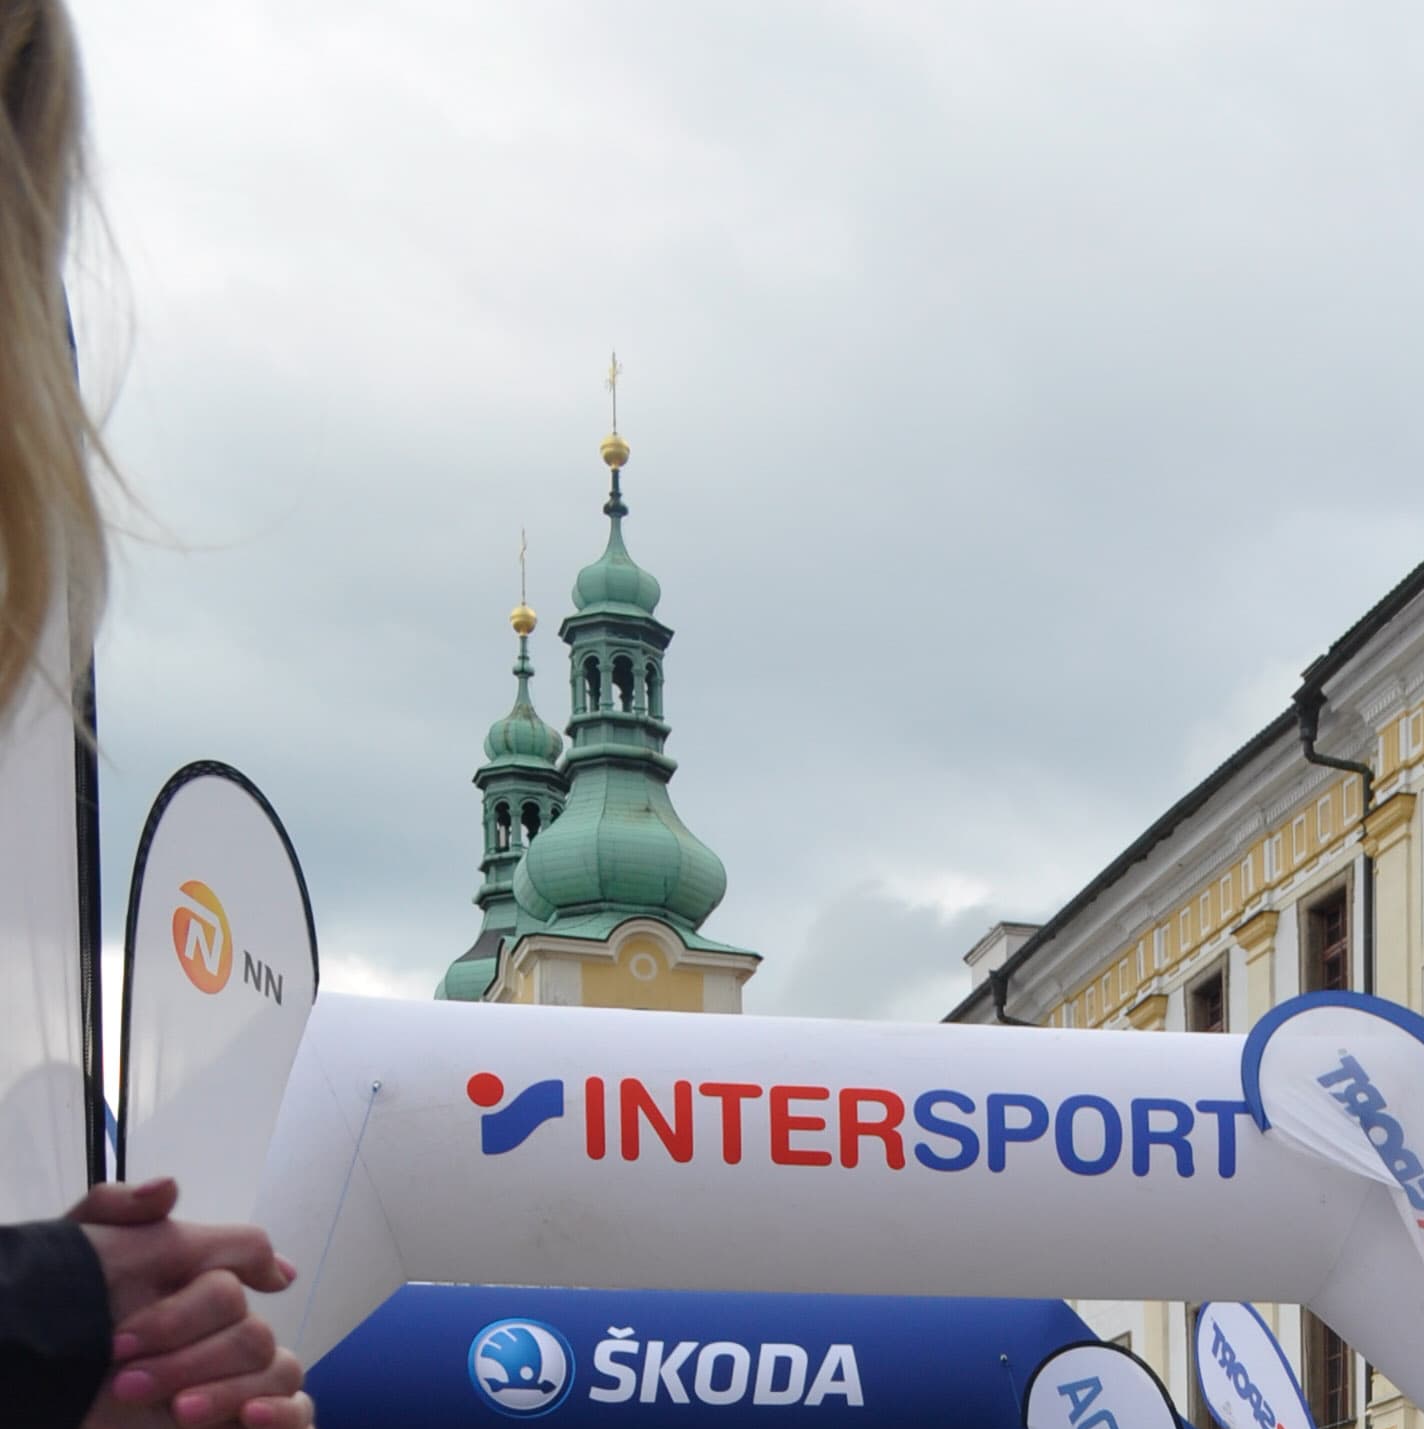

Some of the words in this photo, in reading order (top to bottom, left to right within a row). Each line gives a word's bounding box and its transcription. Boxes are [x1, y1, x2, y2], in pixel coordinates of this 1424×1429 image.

[243, 949, 283, 1006] NN
[584, 1076, 1253, 1179] INTERSPORT
[589, 1326, 865, 1407] ŠKODA
